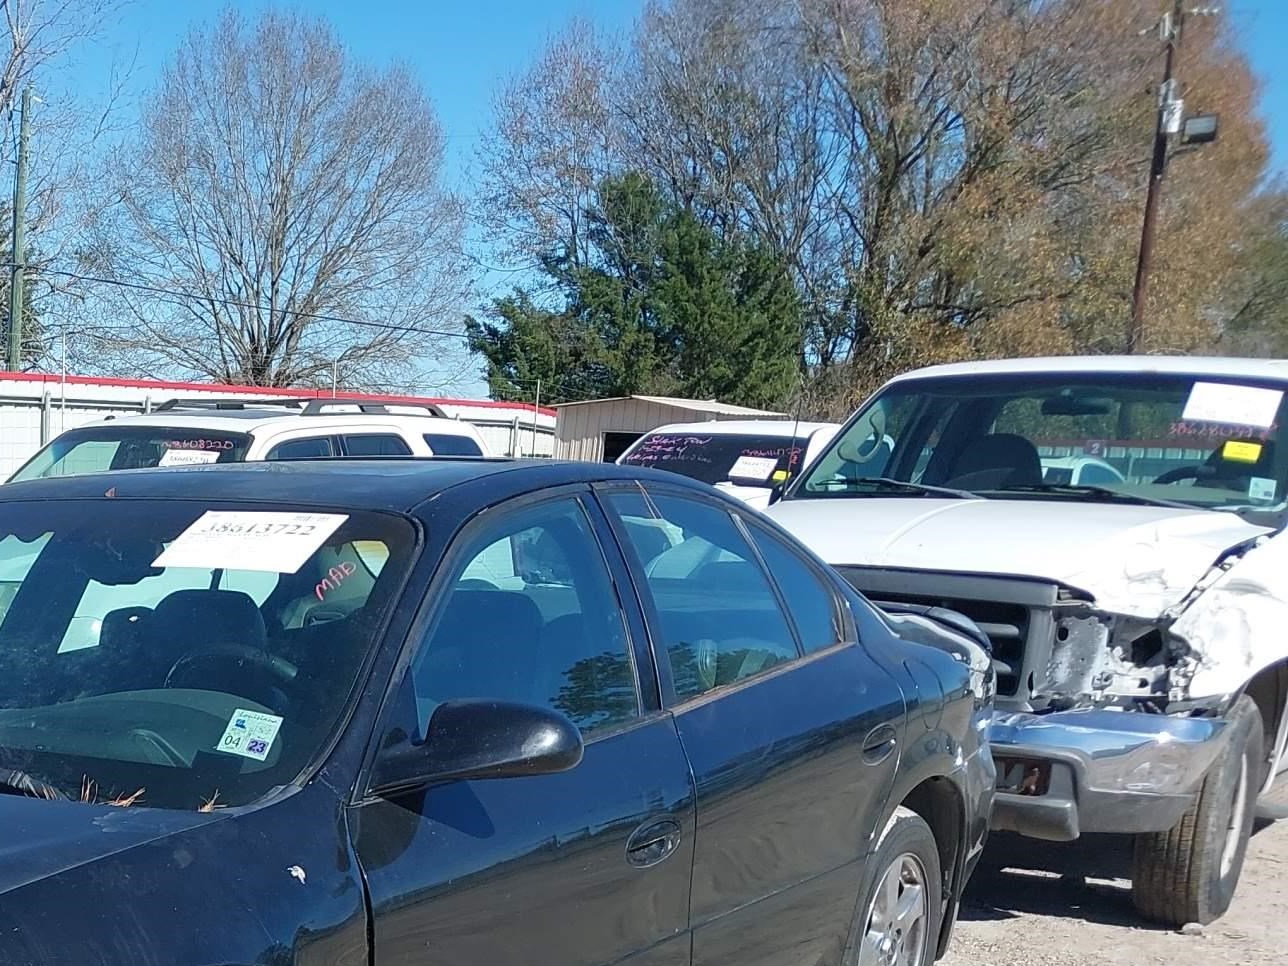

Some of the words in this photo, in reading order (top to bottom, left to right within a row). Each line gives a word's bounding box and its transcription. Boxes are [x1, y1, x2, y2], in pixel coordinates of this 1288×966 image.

[200, 521, 316, 536] 38613722
[224, 735, 240, 748] 04
[248, 741, 266, 753] 23
